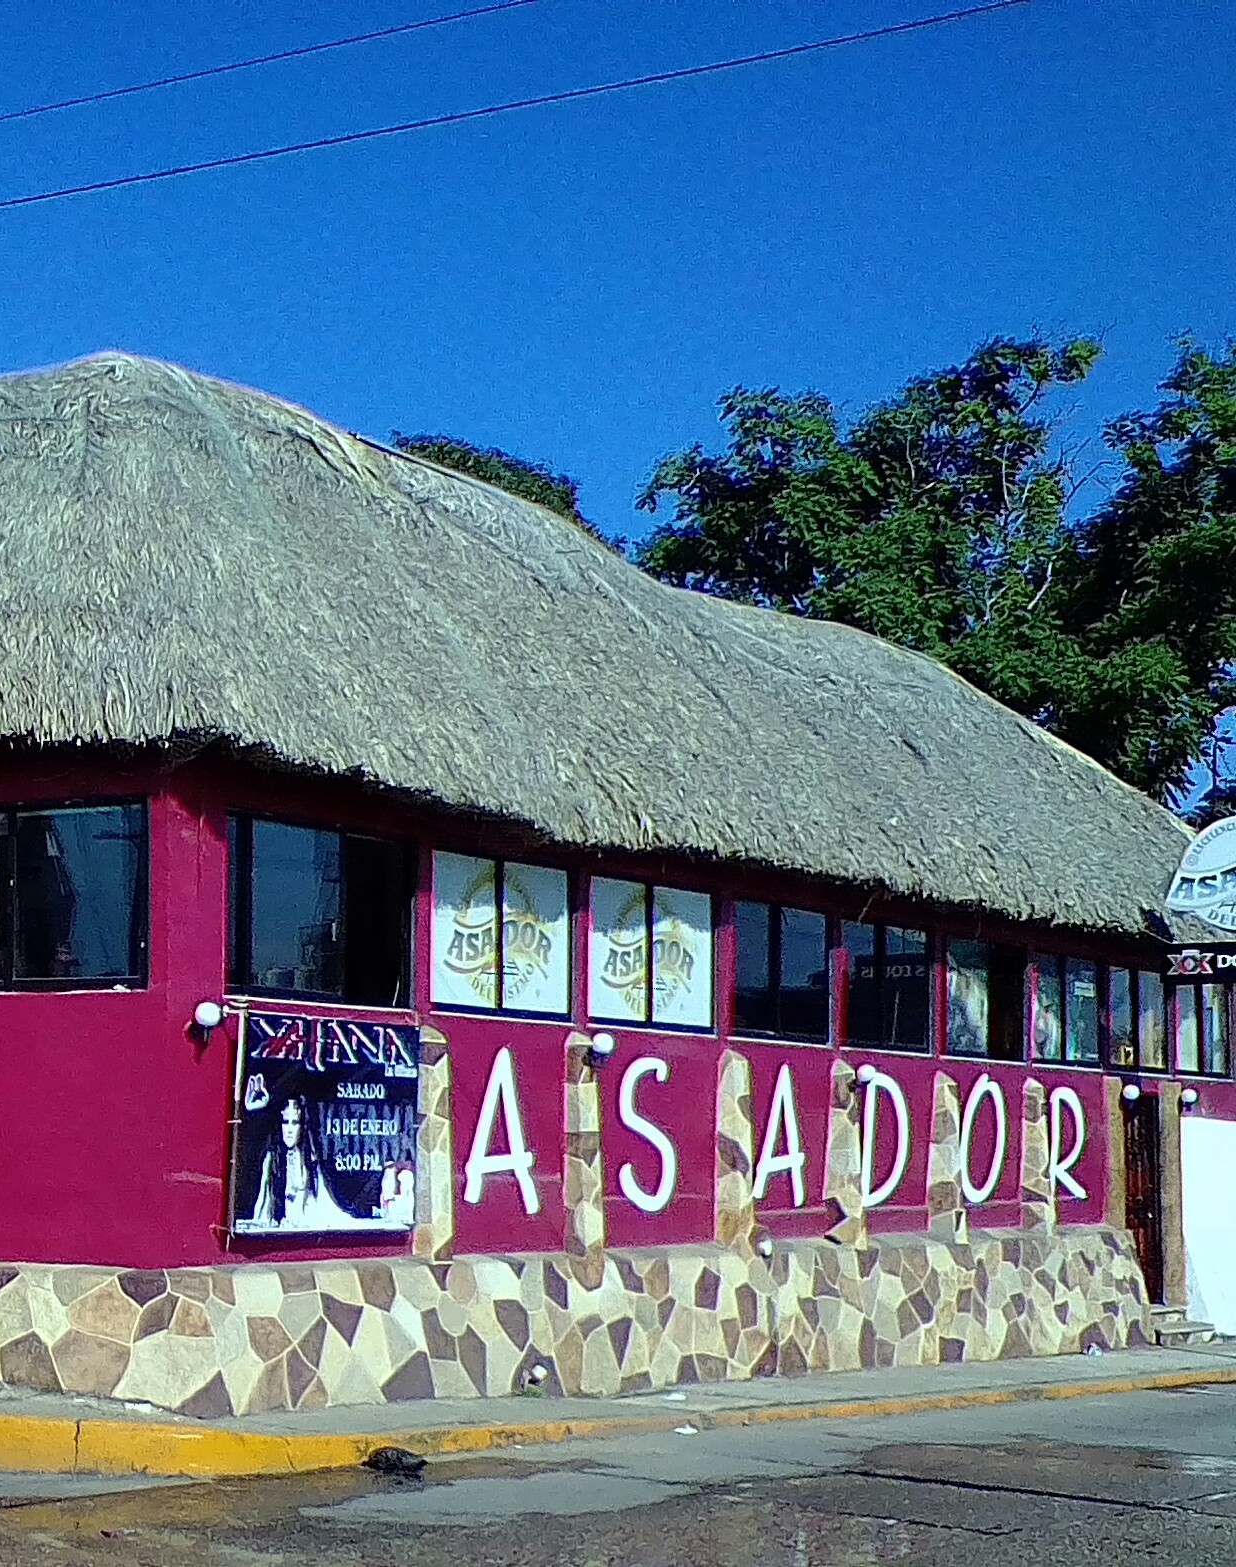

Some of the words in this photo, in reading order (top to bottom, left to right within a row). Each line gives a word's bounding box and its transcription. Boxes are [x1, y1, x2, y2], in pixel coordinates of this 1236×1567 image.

[336, 1083, 386, 1099] SABADO
[326, 1118, 340, 1135] 13
[342, 1119, 358, 1135] DE
[360, 1119, 398, 1136] ENERO
[335, 1153, 361, 1171] 8:00
